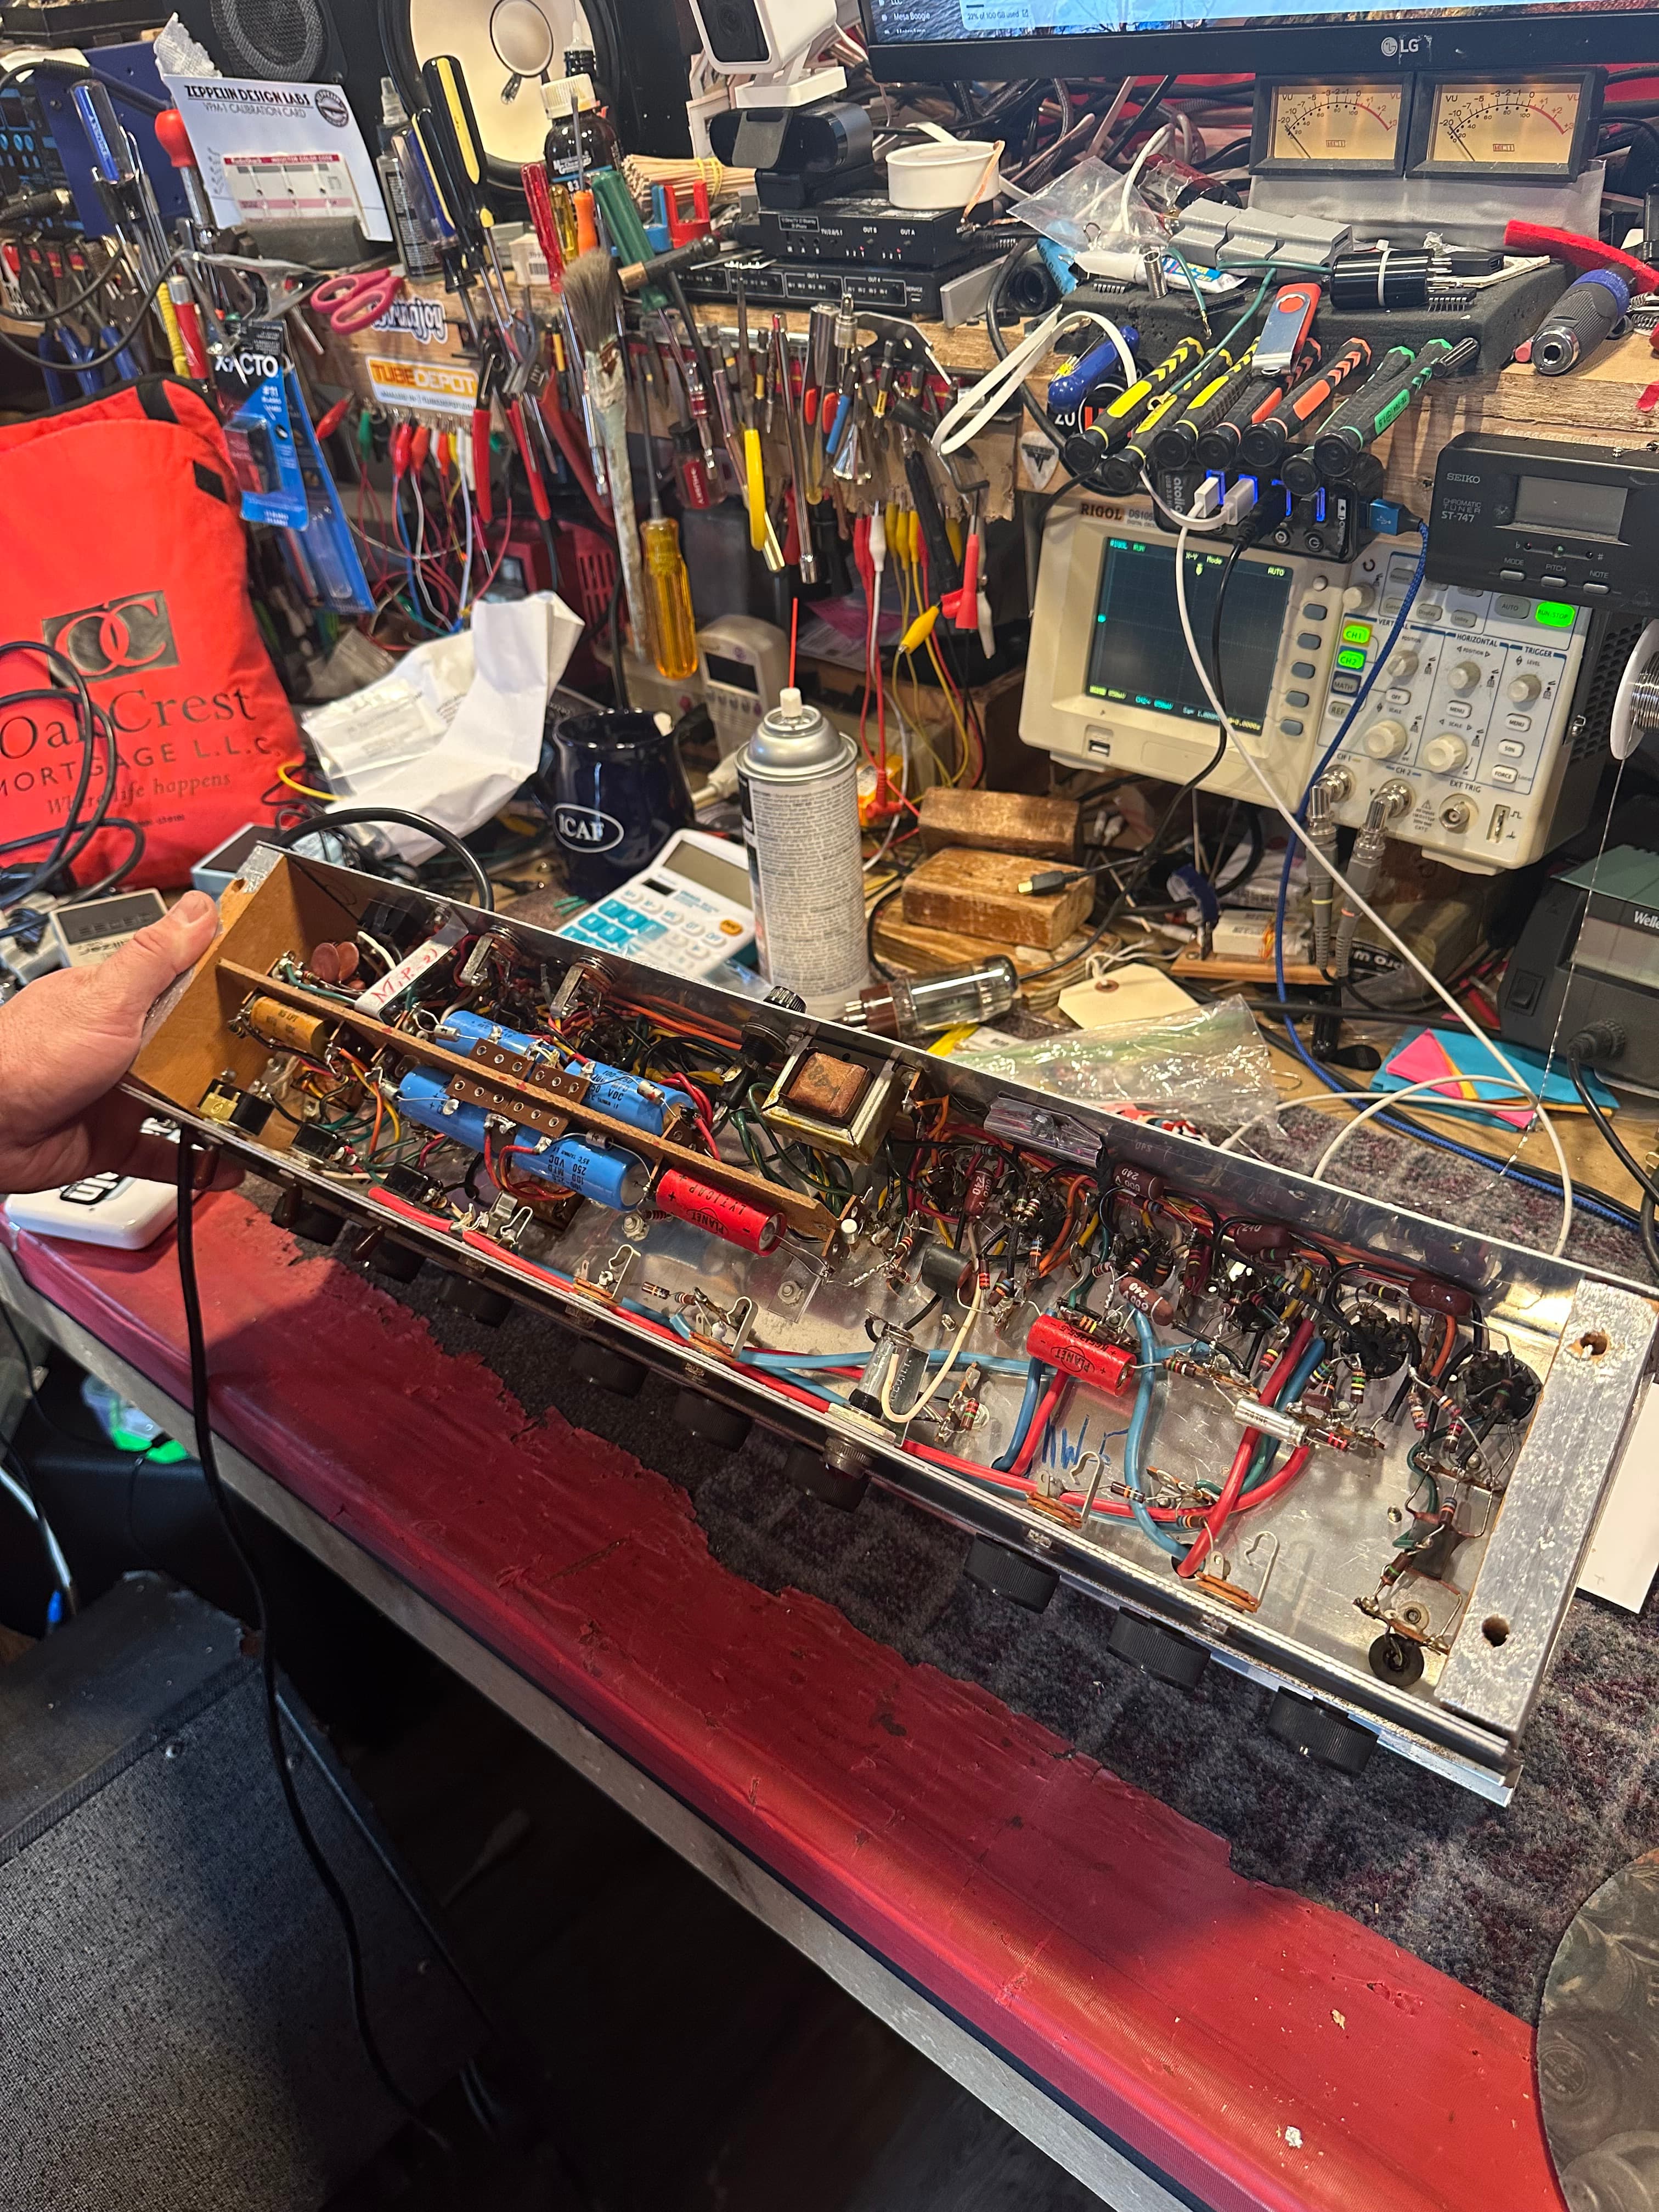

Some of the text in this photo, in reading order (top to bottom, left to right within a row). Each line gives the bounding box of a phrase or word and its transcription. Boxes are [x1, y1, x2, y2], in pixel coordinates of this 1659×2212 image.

[894, 11, 931, 21] Mesa Boogie
[1400, 38, 1419, 53] LG
[184, 85, 311, 105] ZEPPELIN DESIGN LABS
[229, 103, 283, 117] CALIBRATION
[283, 106, 306, 119] CARD
[370, 362, 476, 394] TUBEDEPOT
[1447, 473, 1481, 484] SEIKO
[1443, 498, 1482, 509] CHROMATIC
[1444, 505, 1481, 514] TUNER
[1080, 503, 1122, 520] RIGOL
[1441, 511, 1475, 523] ST-747
[1504, 557, 1525, 567] MODE
[1545, 563, 1567, 572] PITCH
[1267, 565, 1286, 577] AUTO
[1589, 570, 1610, 579] NOTE
[1501, 603, 1519, 612] AUTO
[1376, 618, 1409, 630] VERTL
[1346, 629, 1362, 640] CH1
[1402, 635, 1421, 644] POSITION
[1457, 634, 1498, 647] HORIZONTAL
[1462, 647, 1484, 656] POSITION
[1525, 647, 1553, 658] TRIGGER
[1340, 656, 1357, 666] CH2
[1527, 659, 1541, 667] LEVEL
[1333, 681, 1353, 691] MATH
[109, 686, 257, 733] Crest
[1331, 706, 1346, 715] REF
[1509, 719, 1525, 728] MENU
[1395, 766, 1412, 777] CH 2
[1494, 770, 1513, 780] FORCE
[153, 774, 231, 797] happens
[1449, 779, 1482, 793] EXT TRIG
[587, 1085, 624, 1102] 50 VDC
[548, 1154, 588, 1176] 250 VDC
[548, 1164, 584, 1186] 100 MFD
[1121, 1167, 1139, 1181] 240
[972, 1175, 982, 1196] 240
[1123, 1179, 1141, 1192] 600
[689, 1184, 747, 1216] LYTICAP
[691, 1210, 725, 1235] PLANET
[1128, 1282, 1149, 1298] 240
[1130, 1295, 1149, 1312] 600
[1054, 1351, 1091, 1373] PLANET
